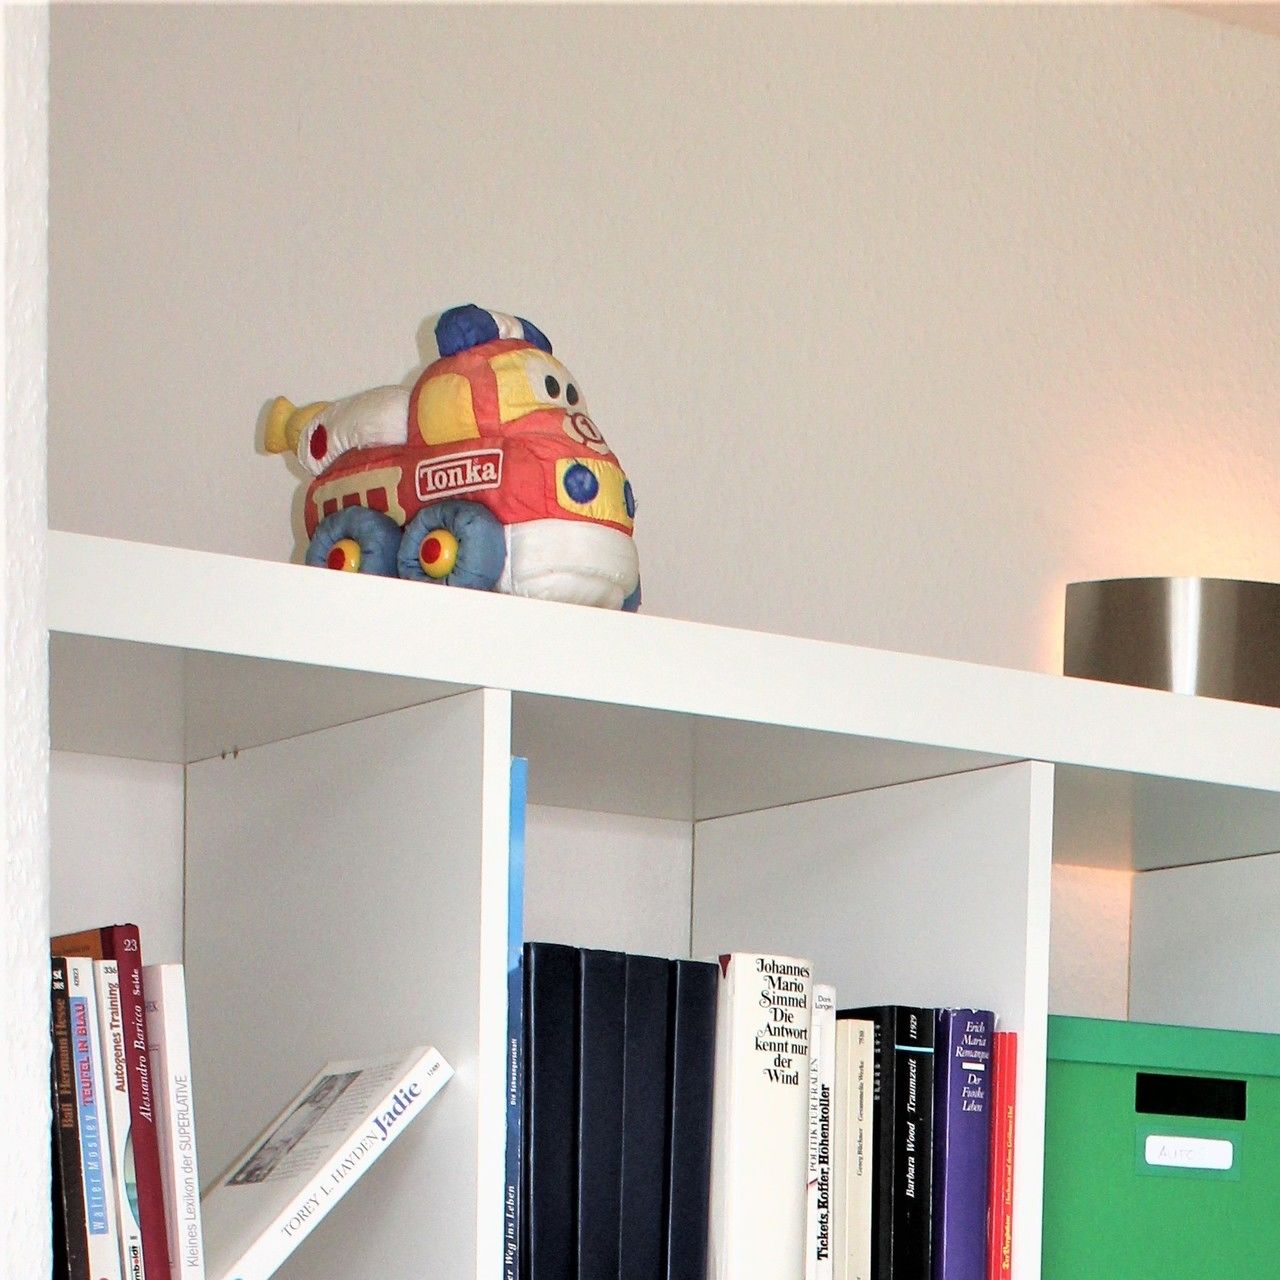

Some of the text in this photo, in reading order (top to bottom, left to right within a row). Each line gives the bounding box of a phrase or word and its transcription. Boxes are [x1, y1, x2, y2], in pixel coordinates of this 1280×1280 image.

[421, 458, 498, 492] Tonka
[124, 939, 138, 952] 23
[756, 958, 810, 978] Johannes
[763, 975, 804, 993] Mario
[759, 990, 807, 1009] Simmel
[769, 1007, 794, 1023] Die
[909, 1014, 918, 1039] 11929
[106, 982, 127, 1092] Autogenes Training
[757, 1022, 808, 1040] Antwort
[132, 968, 153, 1122] Alessandro Baricco Seide
[755, 1036, 808, 1055] kennt nur
[774, 1054, 792, 1068] der
[763, 1069, 799, 1085] Wind
[79, 1057, 99, 1170] Mosley TEUFEL
[817, 1084, 830, 1166] Höhenkoller
[331, 1080, 423, 1184] HAYDEN Jadie
[905, 1058, 917, 1197] Barbara Wood Traumzeit
[174, 1075, 199, 1267] Kleines Lexikon der SUPERLATIVE
[506, 1185, 516, 1218] Leben
[506, 1223, 515, 1239] ins
[505, 1242, 517, 1266] Weg
